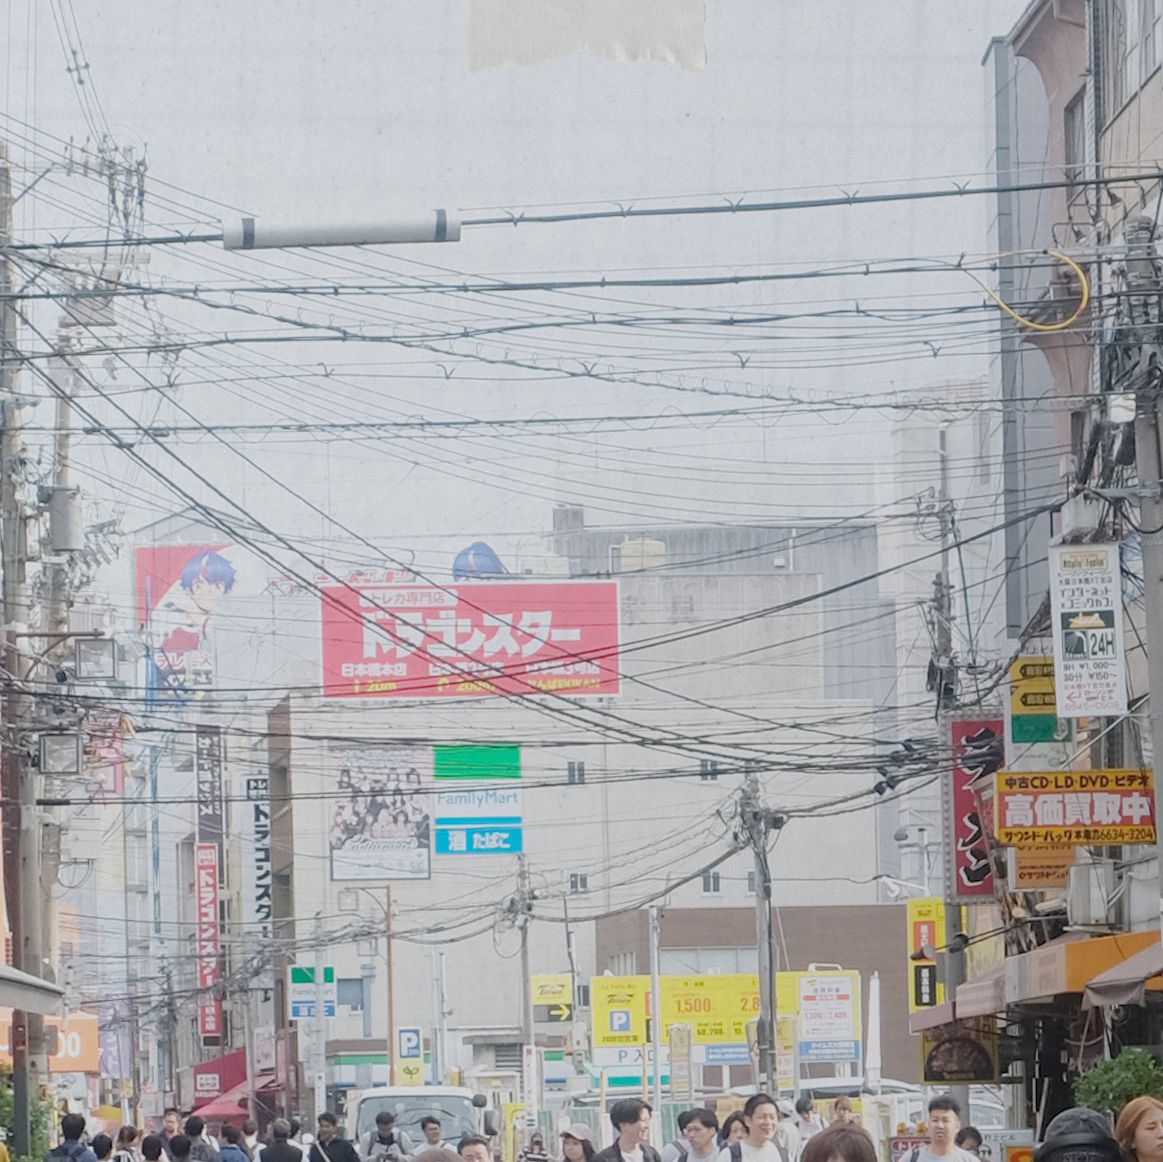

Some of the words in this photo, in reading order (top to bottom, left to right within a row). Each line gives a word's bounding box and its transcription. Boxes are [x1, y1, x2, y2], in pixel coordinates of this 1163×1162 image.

[371, 592, 445, 604] トレカ専門店
[362, 610, 581, 658] ドラゴンスター
[1090, 631, 1115, 656] 24H
[341, 663, 407, 676] 日本橋本店
[437, 790, 519, 807] FamilyMart
[1004, 792, 1151, 827] 高価買取中
[448, 830, 467, 851] 酒
[472, 832, 511, 849] たばこ
[199, 868, 217, 986] ドラゴンスター
[676, 997, 712, 1013] 1,500
[611, 1012, 628, 1031] P
[400, 1031, 419, 1056] P
